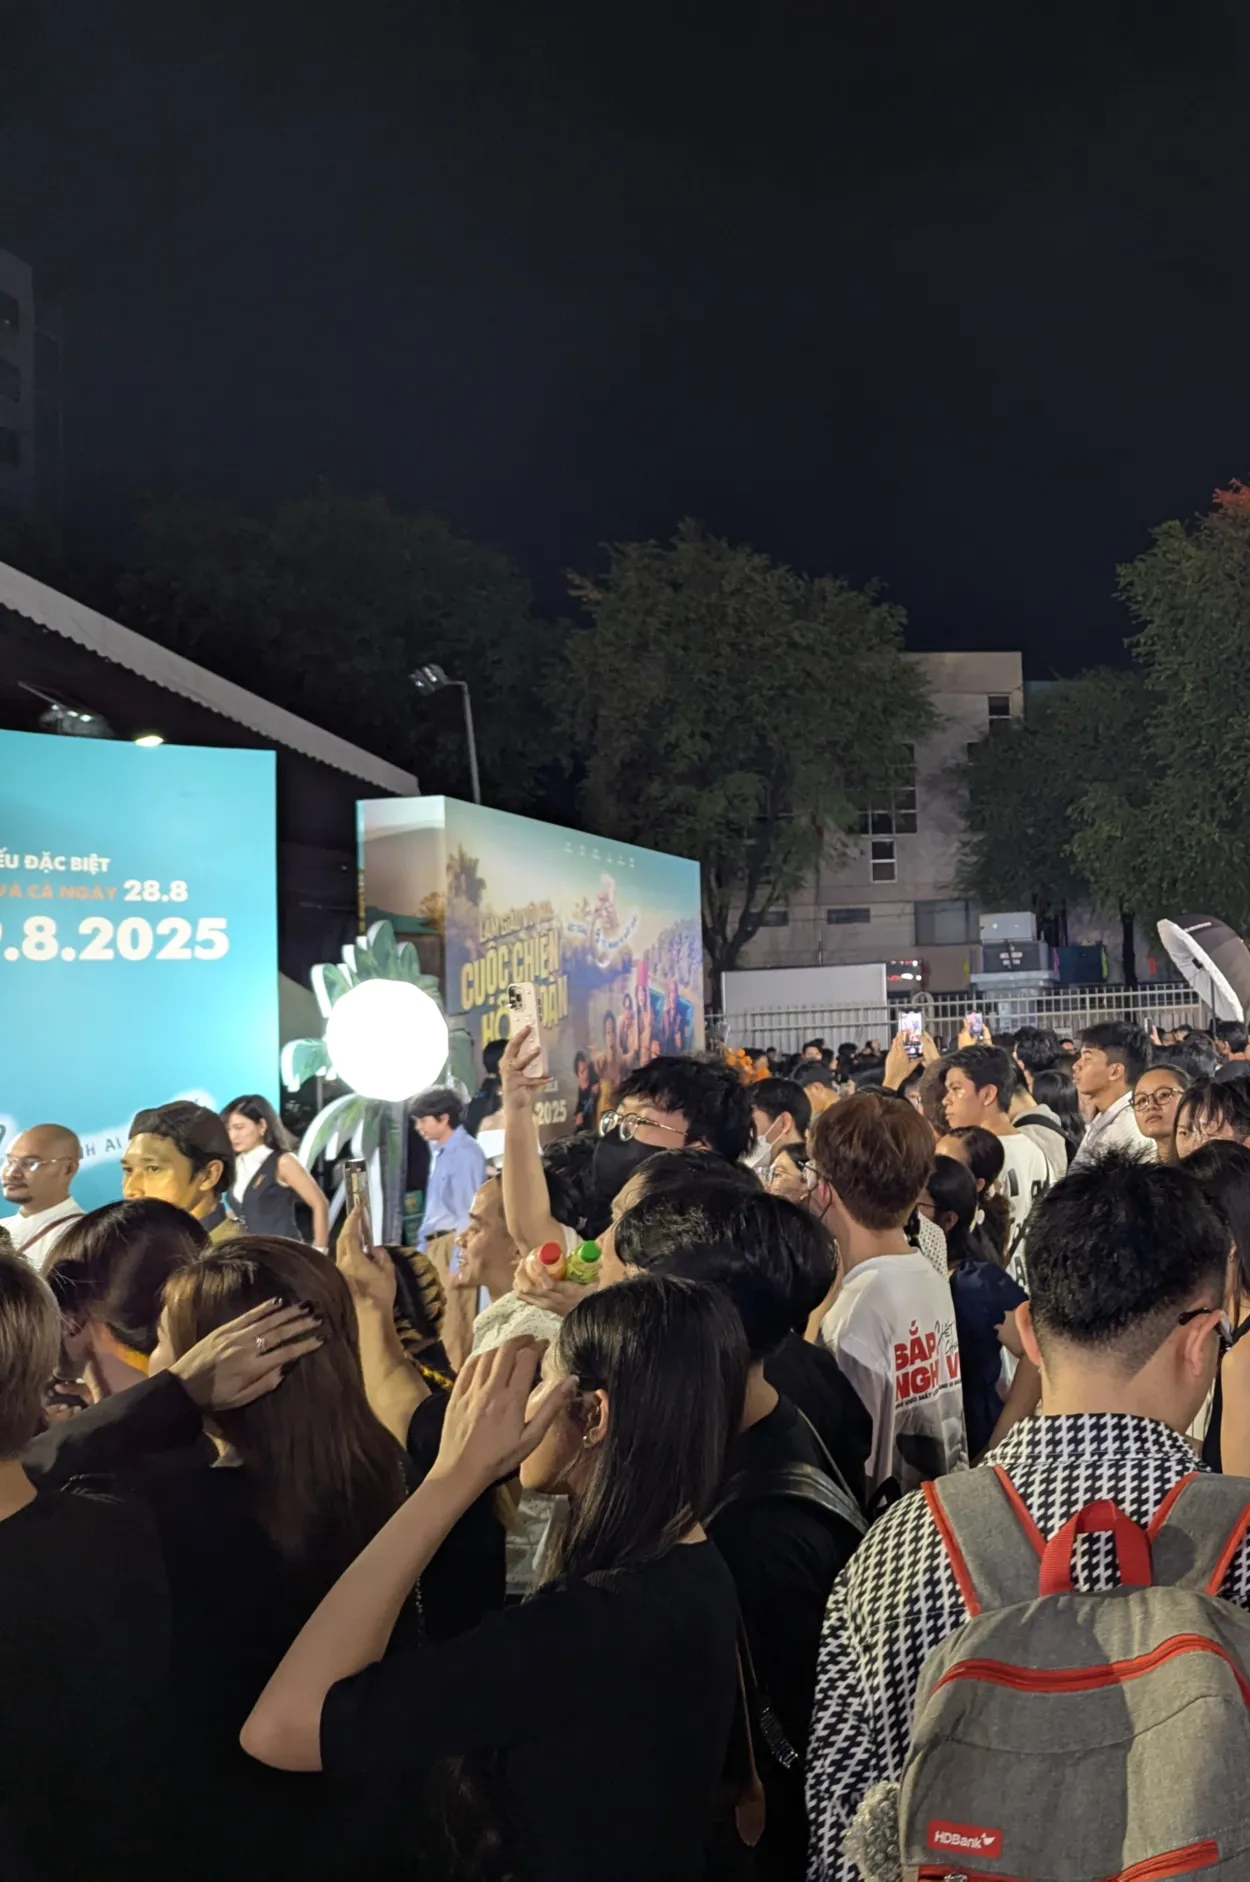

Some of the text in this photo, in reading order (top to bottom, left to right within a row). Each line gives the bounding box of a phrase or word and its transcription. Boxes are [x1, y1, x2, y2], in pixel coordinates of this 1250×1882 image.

[24, 852, 66, 873] ĐẶC
[70, 853, 111, 875] BIỆT
[123, 879, 188, 902] 28.8
[0, 915, 230, 962] .8.2025
[461, 939, 509, 1011] CUỘC
[512, 924, 561, 984] CHIẾN
[535, 1099, 568, 1125] 2025
[894, 1319, 936, 1372] BẮP
[895, 1358, 940, 1402] NGH
[934, 1830, 982, 1849] HDBank
